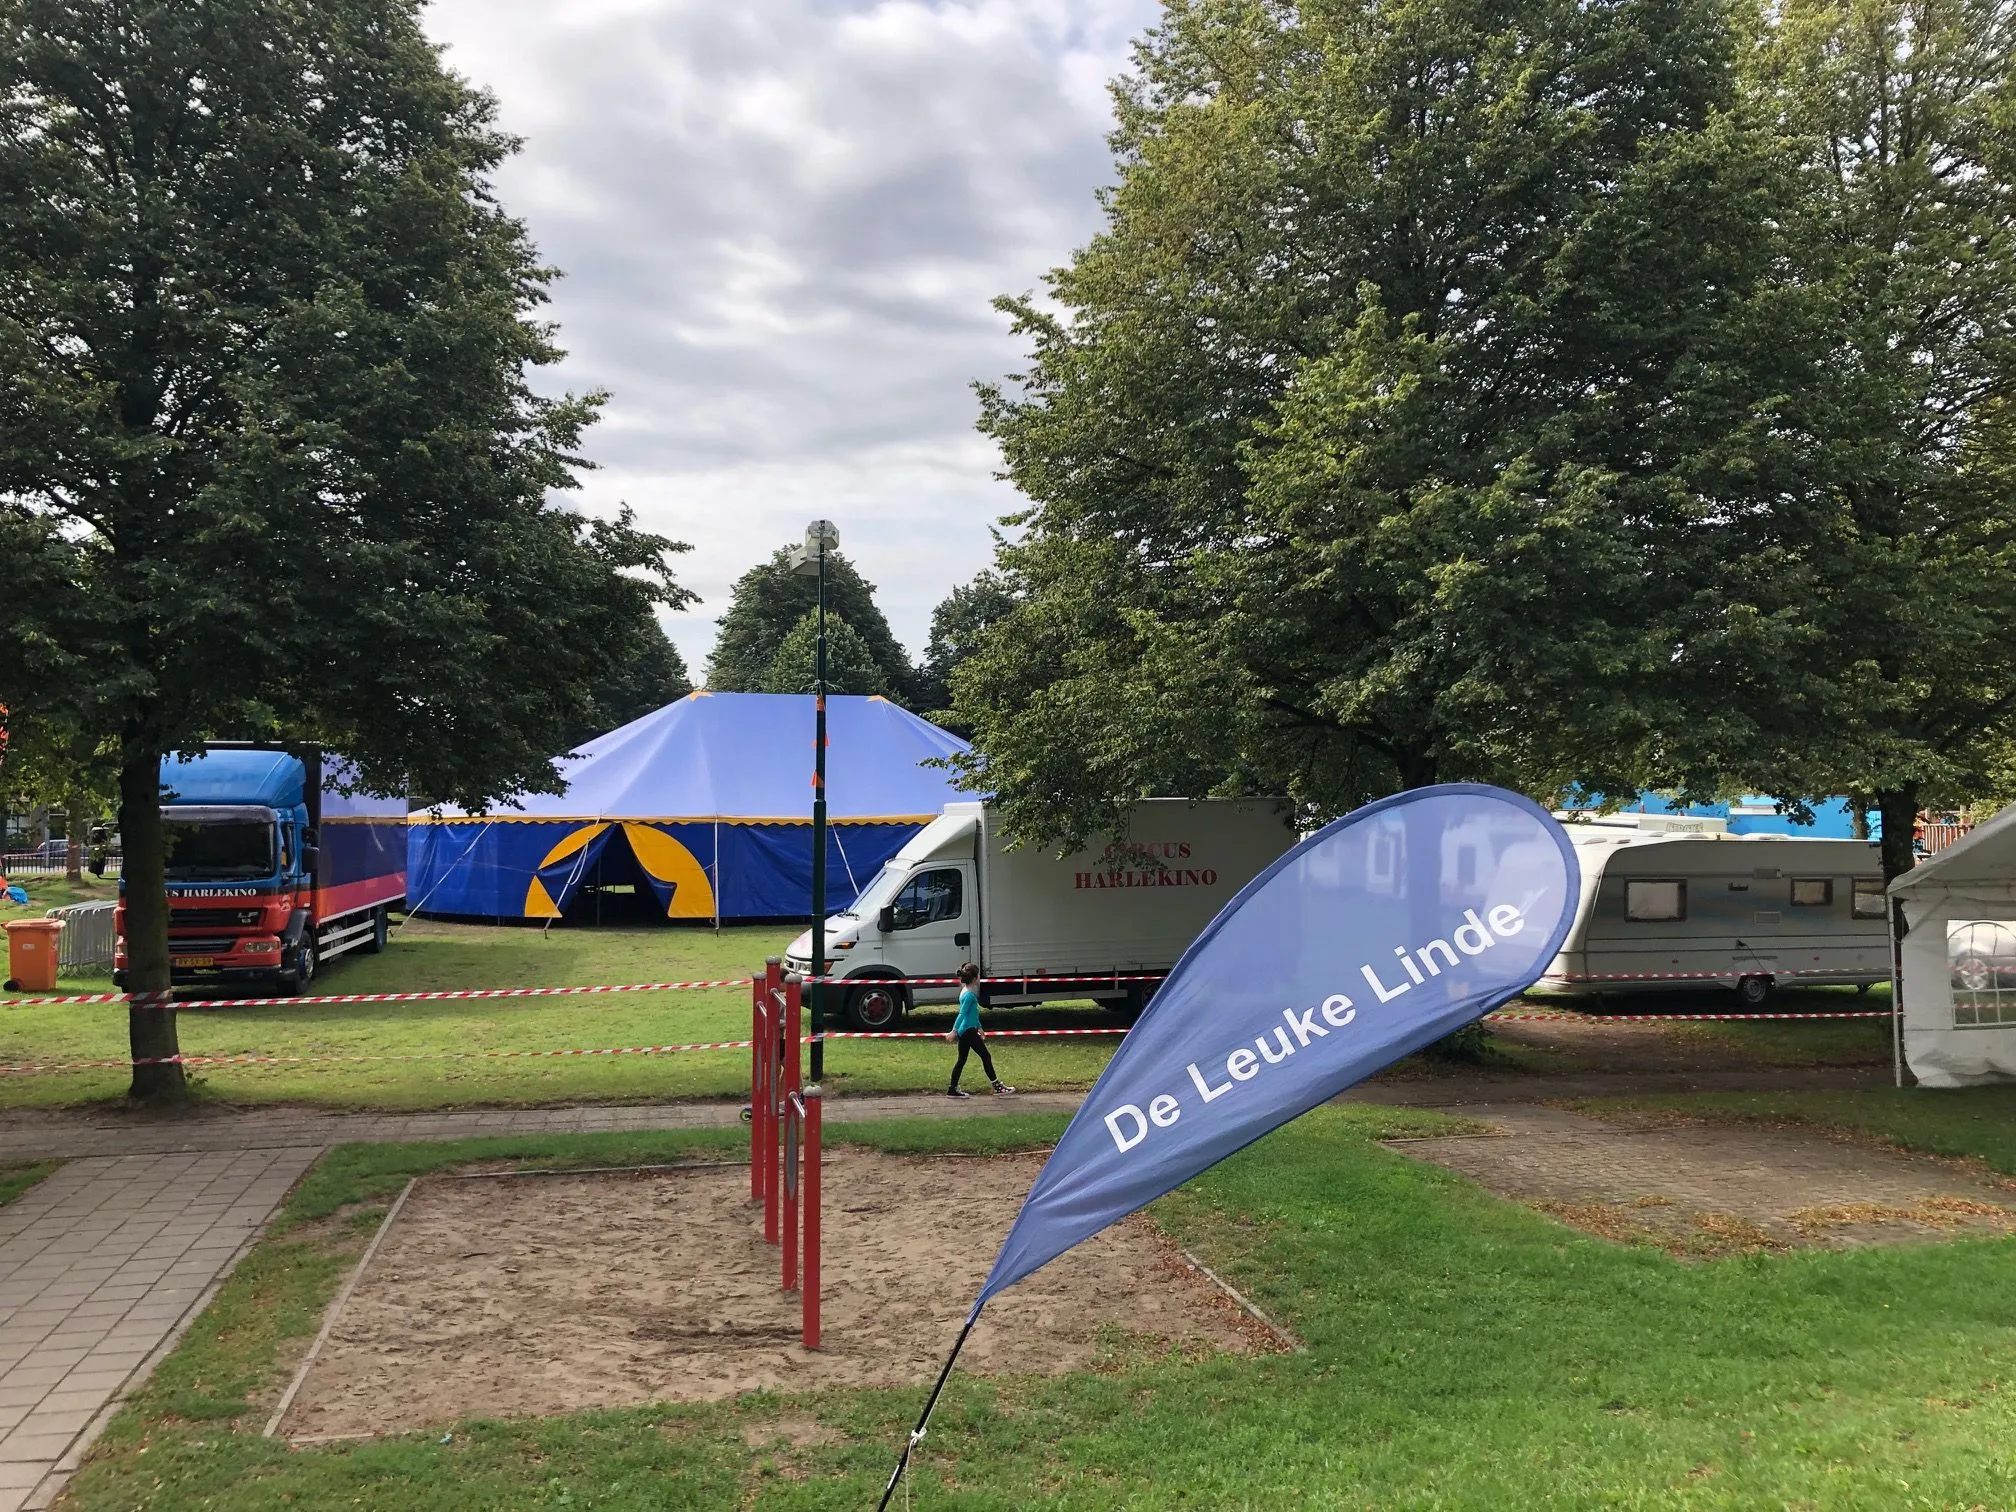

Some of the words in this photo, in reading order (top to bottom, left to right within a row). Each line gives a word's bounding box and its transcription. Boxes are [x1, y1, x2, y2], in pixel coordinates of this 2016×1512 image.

[1104, 841, 1191, 859] CRCUS
[1074, 869, 1218, 889] HARLEKINO
[183, 888, 257, 898] HARLEKINO
[1104, 1093, 1181, 1154] De
[1186, 993, 1356, 1103] Leuke
[1359, 903, 1525, 1004] Linde
